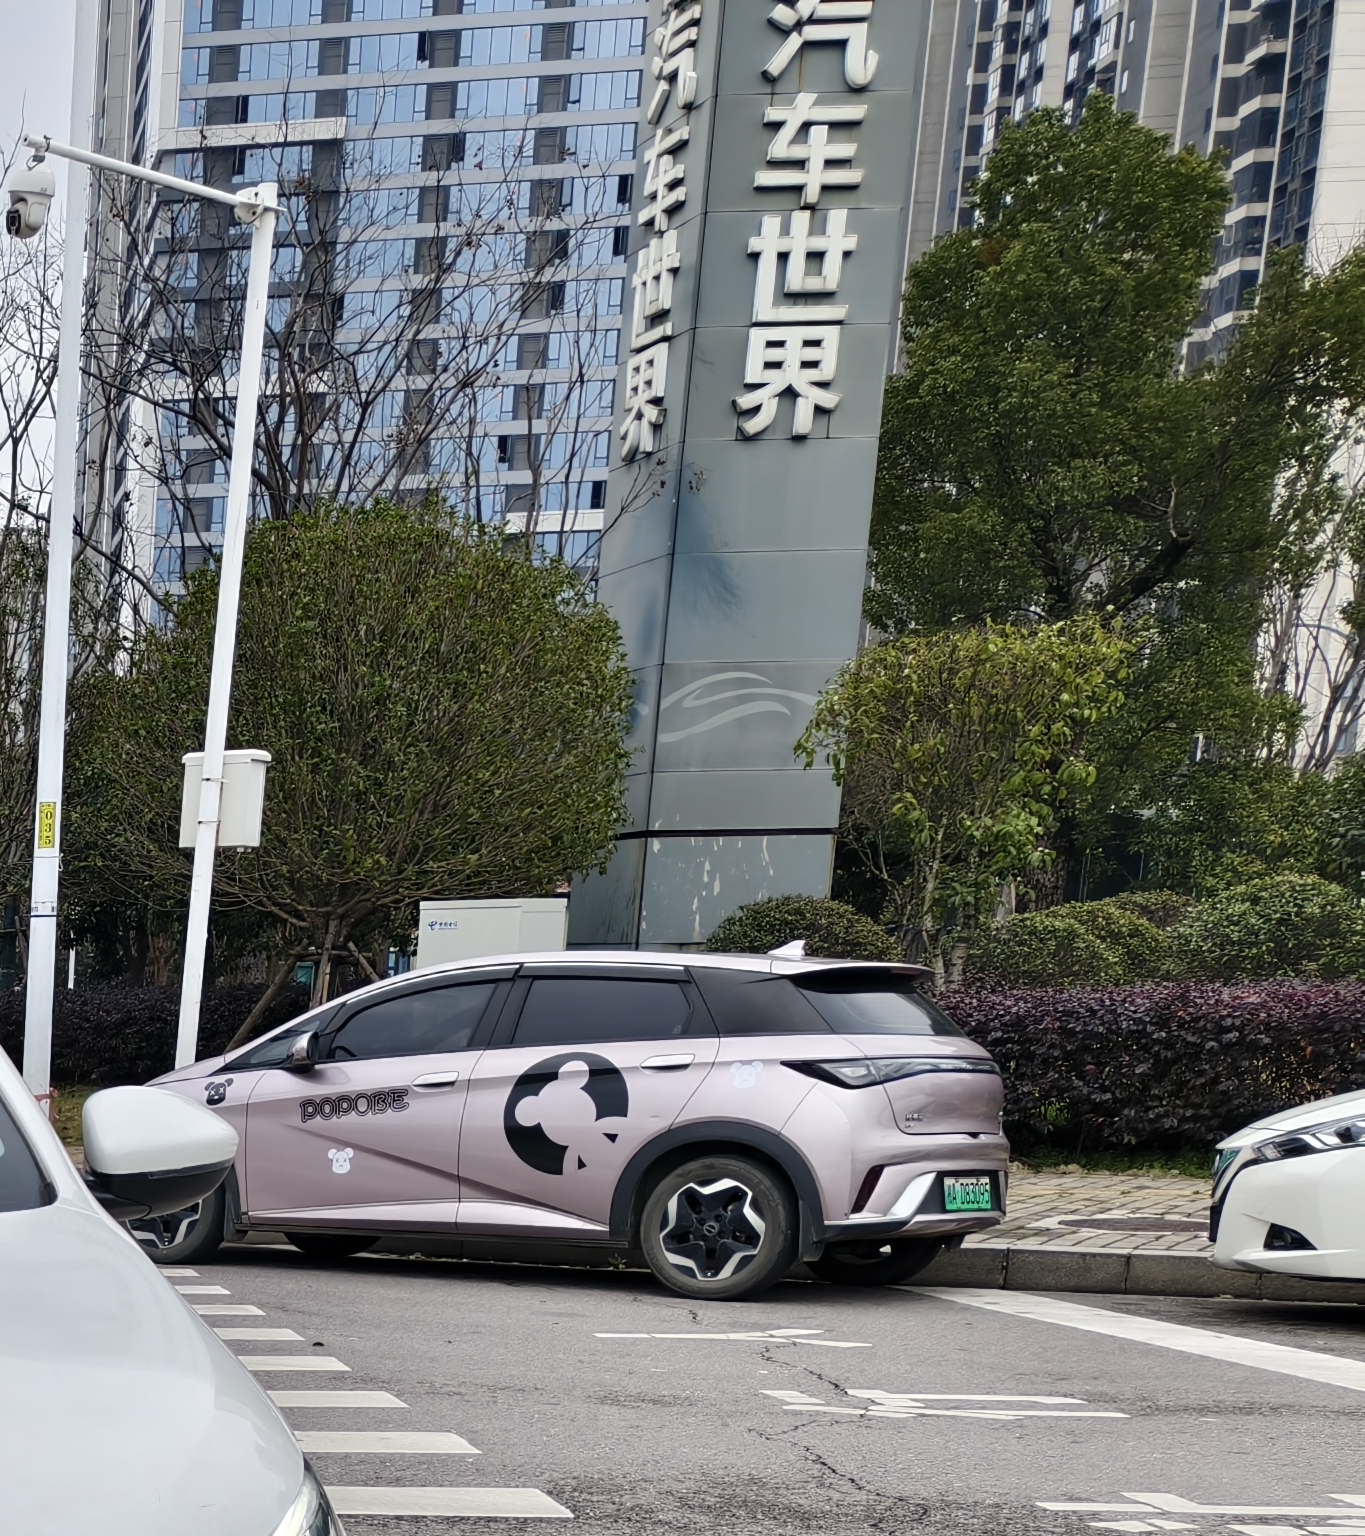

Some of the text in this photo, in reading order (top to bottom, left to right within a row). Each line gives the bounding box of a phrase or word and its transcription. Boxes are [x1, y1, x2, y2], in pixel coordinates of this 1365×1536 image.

[620, 0, 705, 461] 汽车世界
[733, 0, 880, 438] 汽车世界
[300, 1088, 410, 1123] POPOBE
